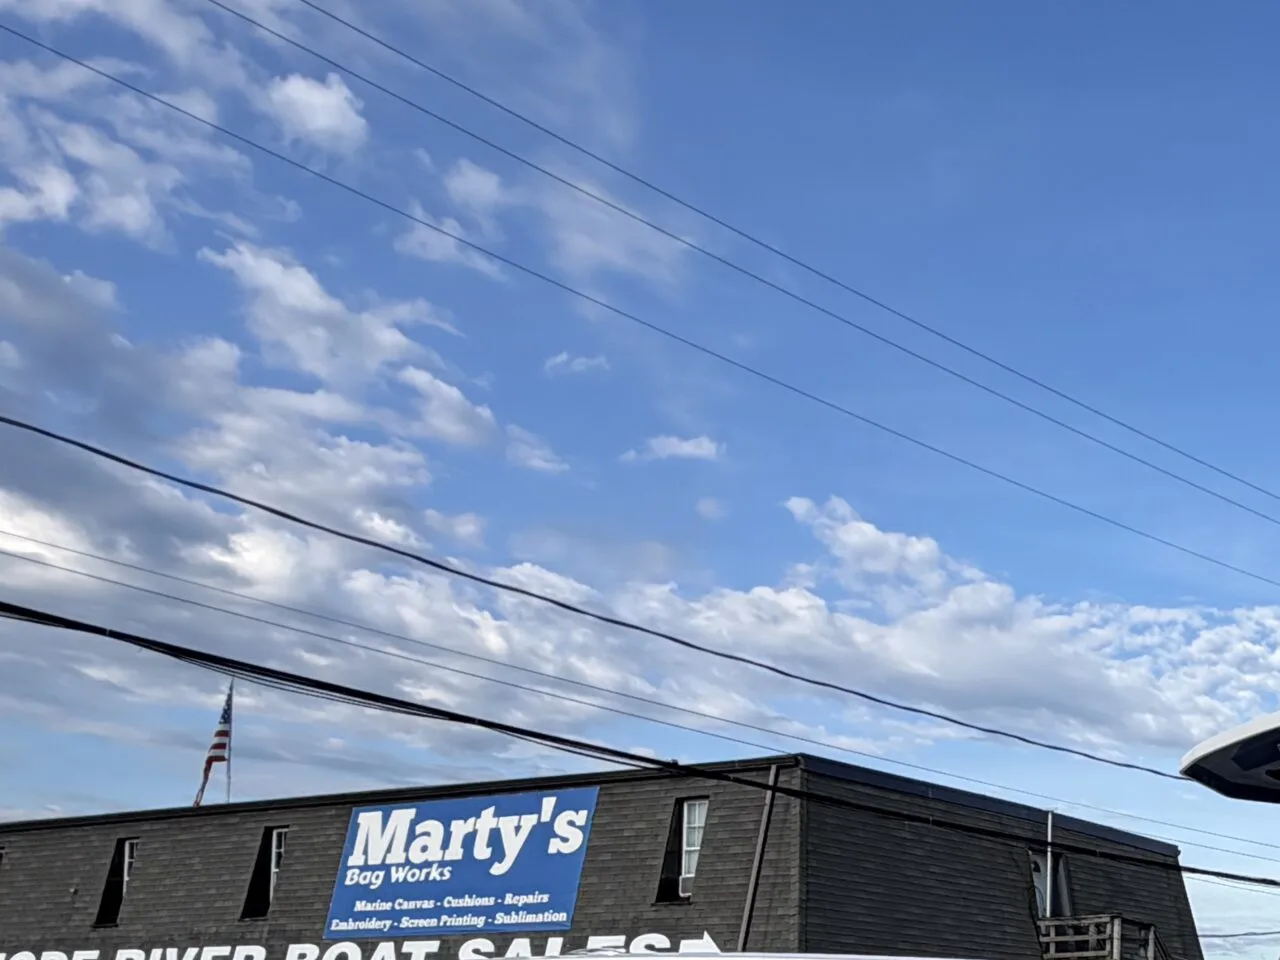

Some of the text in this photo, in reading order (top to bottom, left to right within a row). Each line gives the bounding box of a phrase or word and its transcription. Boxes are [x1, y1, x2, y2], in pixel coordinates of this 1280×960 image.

[347, 797, 588, 876] Marty's
[344, 864, 452, 889] Bag Works
[354, 891, 550, 912] Marine Canvas Cushions Repairs
[331, 909, 567, 932] Embroidery Screen Printing Sublimation
